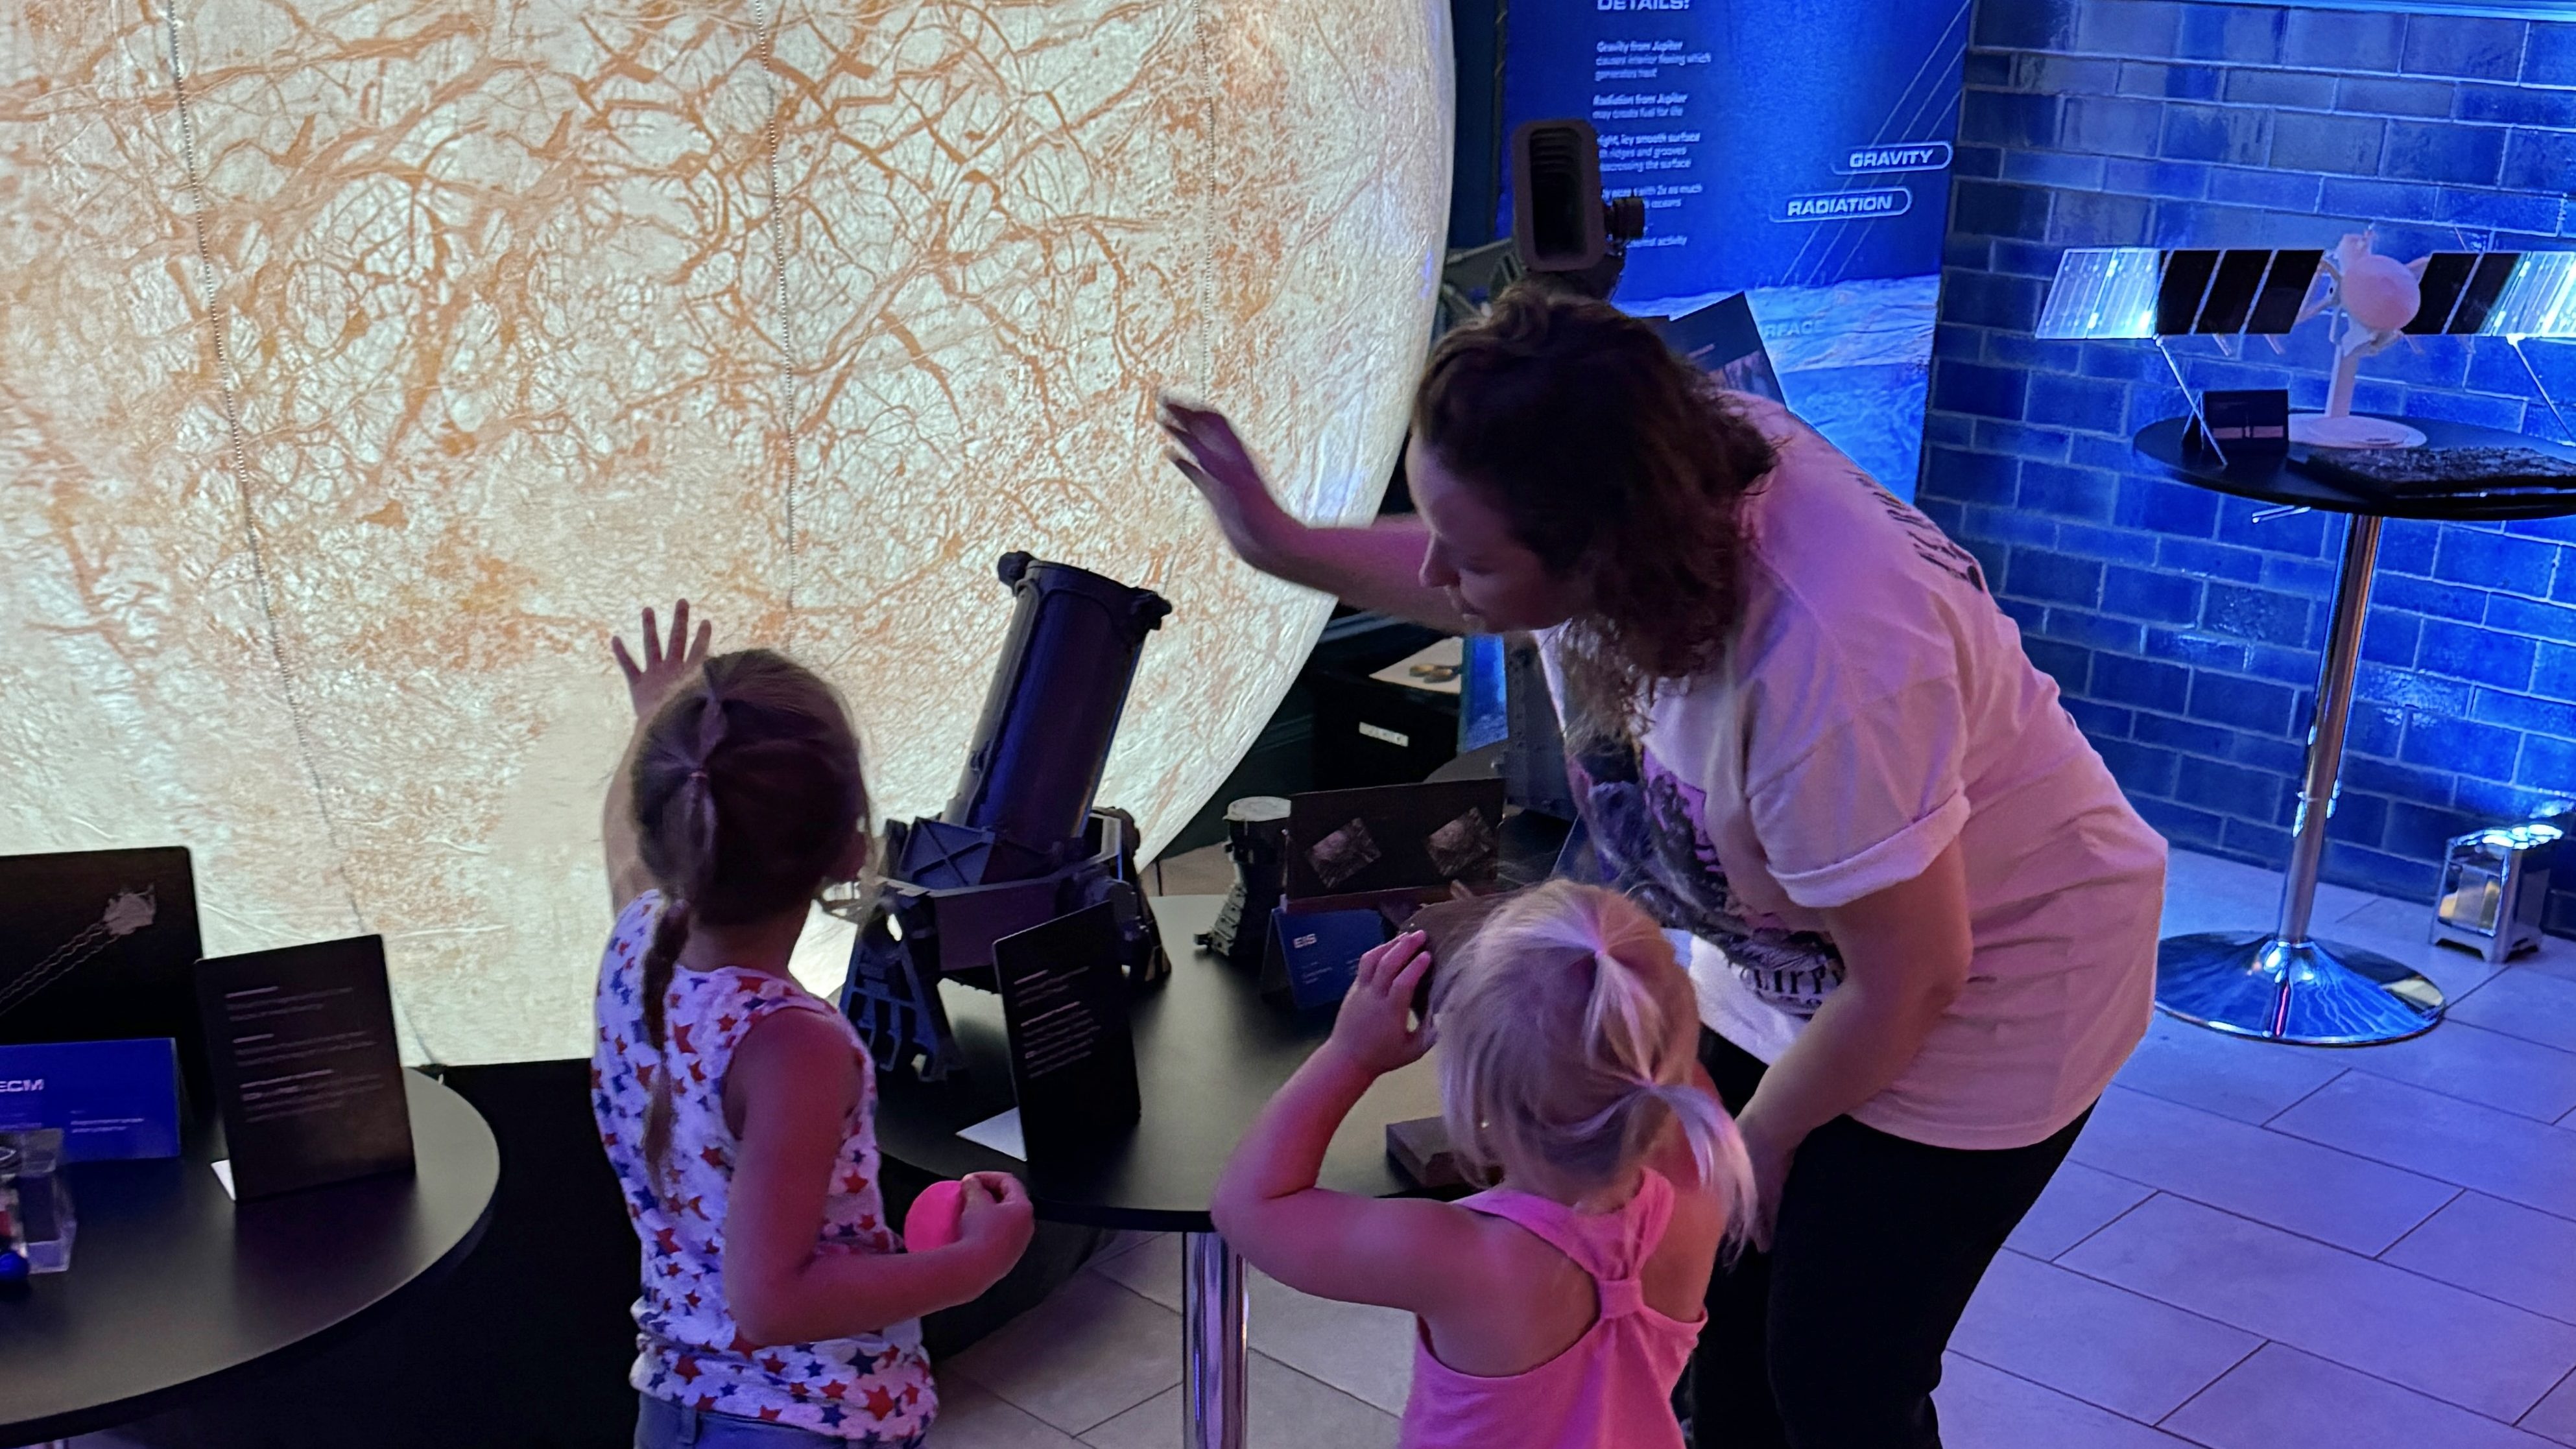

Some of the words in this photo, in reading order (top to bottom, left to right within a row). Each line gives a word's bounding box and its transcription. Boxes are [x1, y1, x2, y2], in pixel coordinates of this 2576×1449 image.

[1597, 40, 1629, 54] Gravity
[1630, 40, 1651, 51] from
[1652, 40, 1683, 52] Jupiter
[1593, 95, 1634, 106] Radiation
[1635, 94, 1656, 104] from
[1657, 93, 1688, 105] Jupiter
[1636, 147, 1653, 157] and
[1654, 147, 1687, 158] grooves
[1850, 148, 1934, 168] GRAVITY
[1645, 160, 1659, 170] the
[1660, 158, 1691, 169] surface
[1787, 194, 1894, 217] RADIATION
[1763, 318, 1826, 337] RFACE
[1293, 933, 1317, 948] EIS
